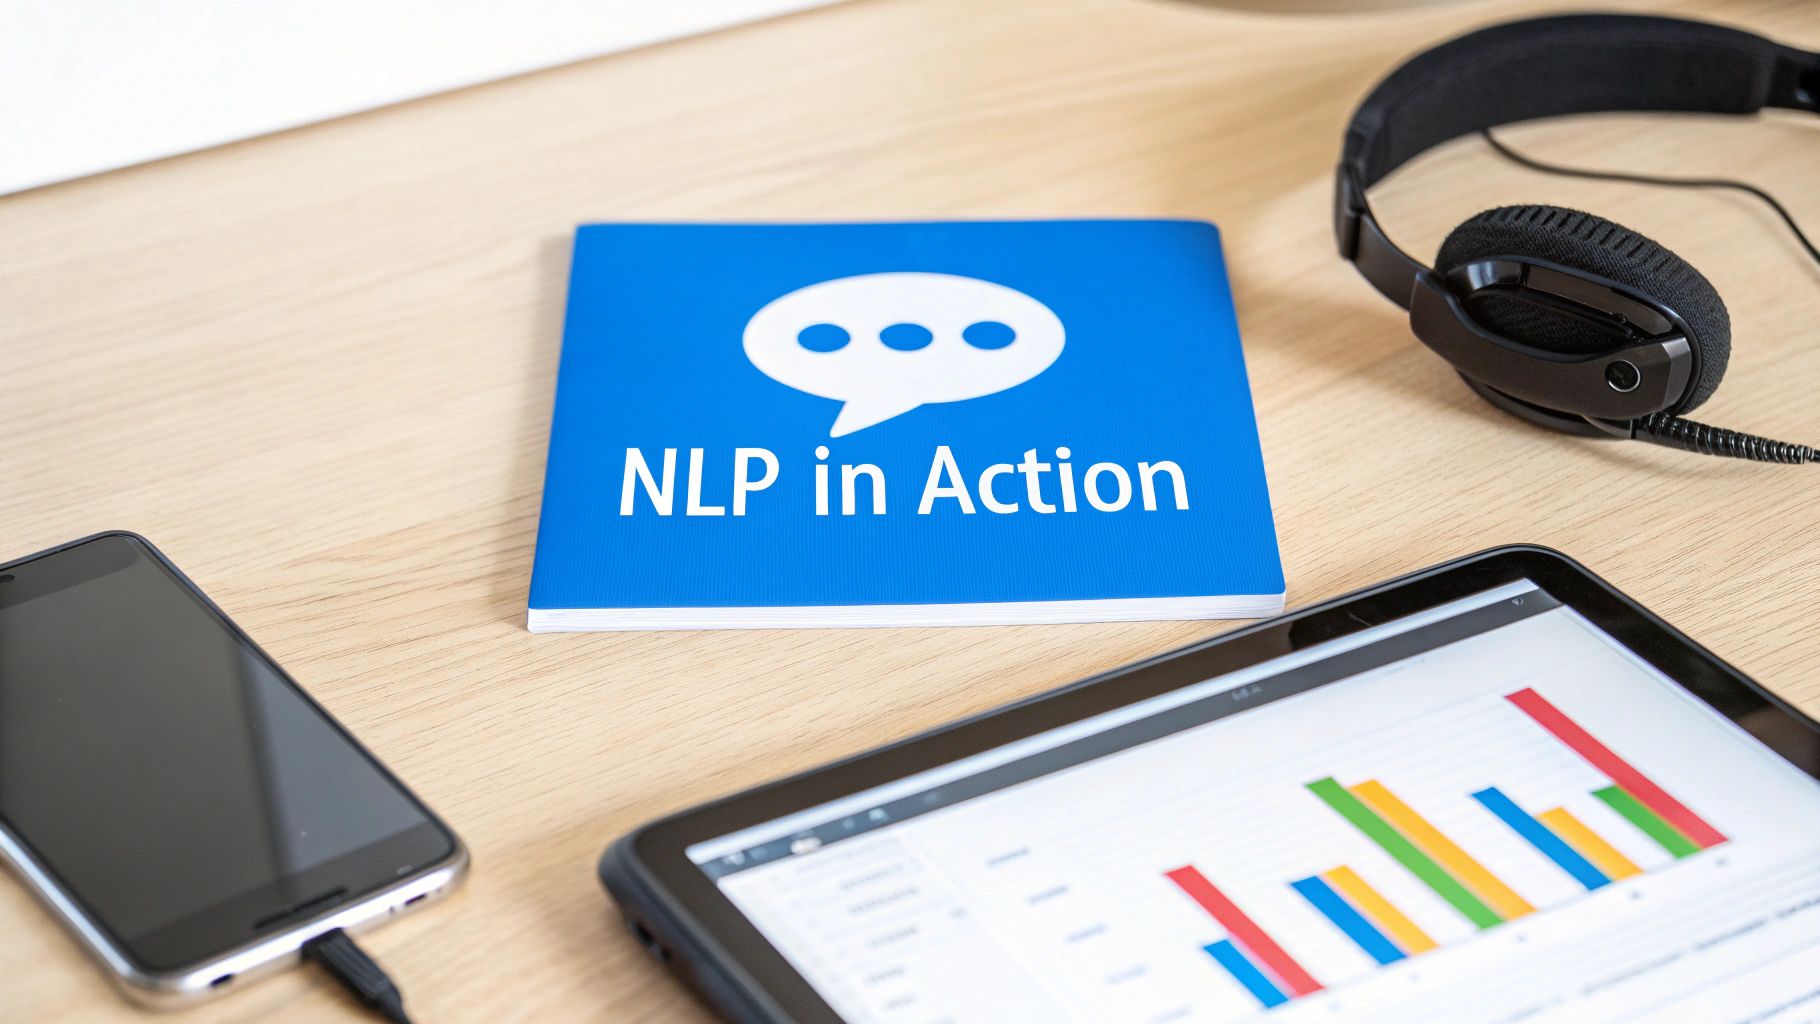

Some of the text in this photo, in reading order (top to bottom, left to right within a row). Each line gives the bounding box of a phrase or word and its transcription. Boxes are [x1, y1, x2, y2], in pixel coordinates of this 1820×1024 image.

[620, 446, 1190, 517] NLP in Action
